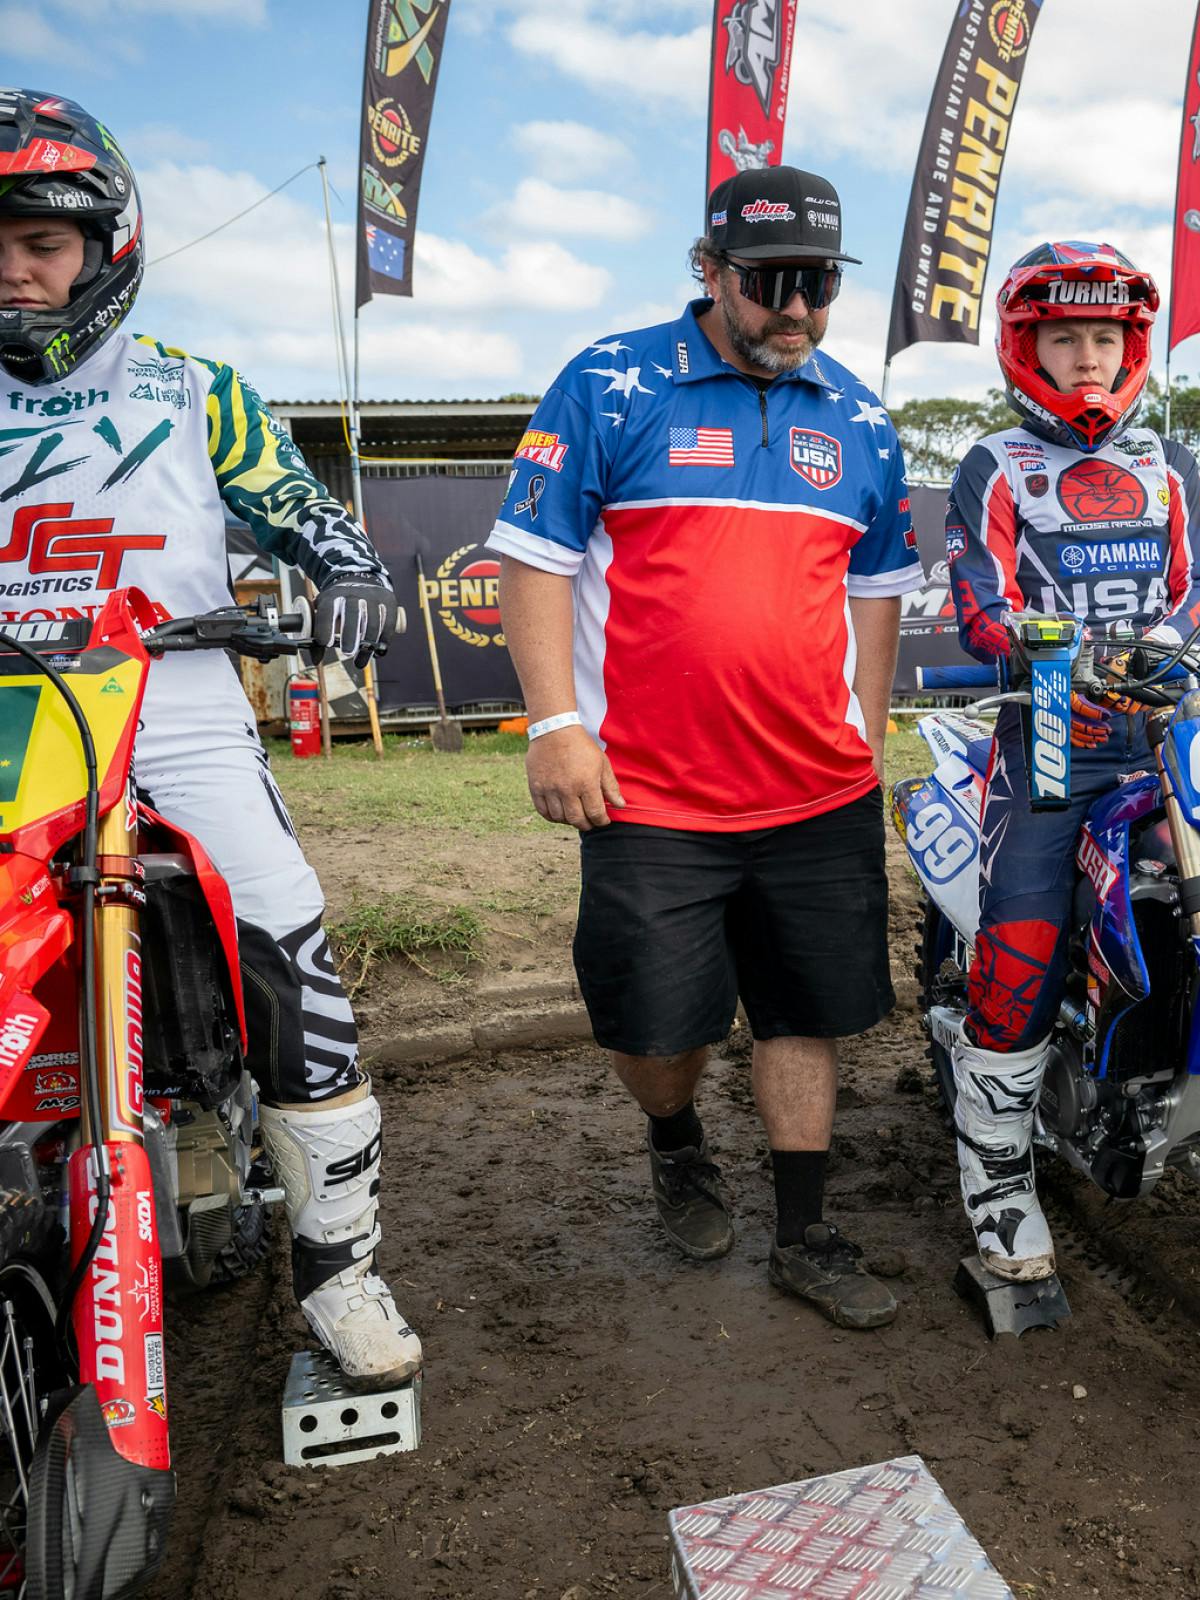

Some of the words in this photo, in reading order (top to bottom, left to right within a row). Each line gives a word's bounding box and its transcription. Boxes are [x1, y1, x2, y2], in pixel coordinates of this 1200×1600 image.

[944, 0, 985, 120] AUSTRALIAN
[368, 105, 421, 155] PENRITE
[932, 127, 954, 183] MADE
[925, 191, 944, 233] AND
[929, 56, 1019, 331] PENRITE
[911, 243, 933, 315] OWNED
[1047, 279, 1131, 305] TURNER
[677, 341, 689, 374] USA
[793, 446, 838, 472] USA
[1019, 461, 1047, 471] 100%
[1129, 456, 1158, 470] AMA
[946, 539, 965, 551] SA
[1063, 521, 1111, 532] MOOSE
[1112, 519, 1153, 530] RACING
[1072, 563, 1158, 574] RACING
[1084, 541, 1161, 565] YAMAHA
[420, 577, 500, 608] PENR
[1040, 577, 1173, 619] USA
[931, 728, 951, 754] DUNLOP
[1033, 668, 1070, 798] 100%
[906, 802, 975, 879] 99
[1077, 833, 1120, 904] USA
[136, 1190, 153, 1243] SKDA
[154, 1340, 163, 1383] BOOTS
